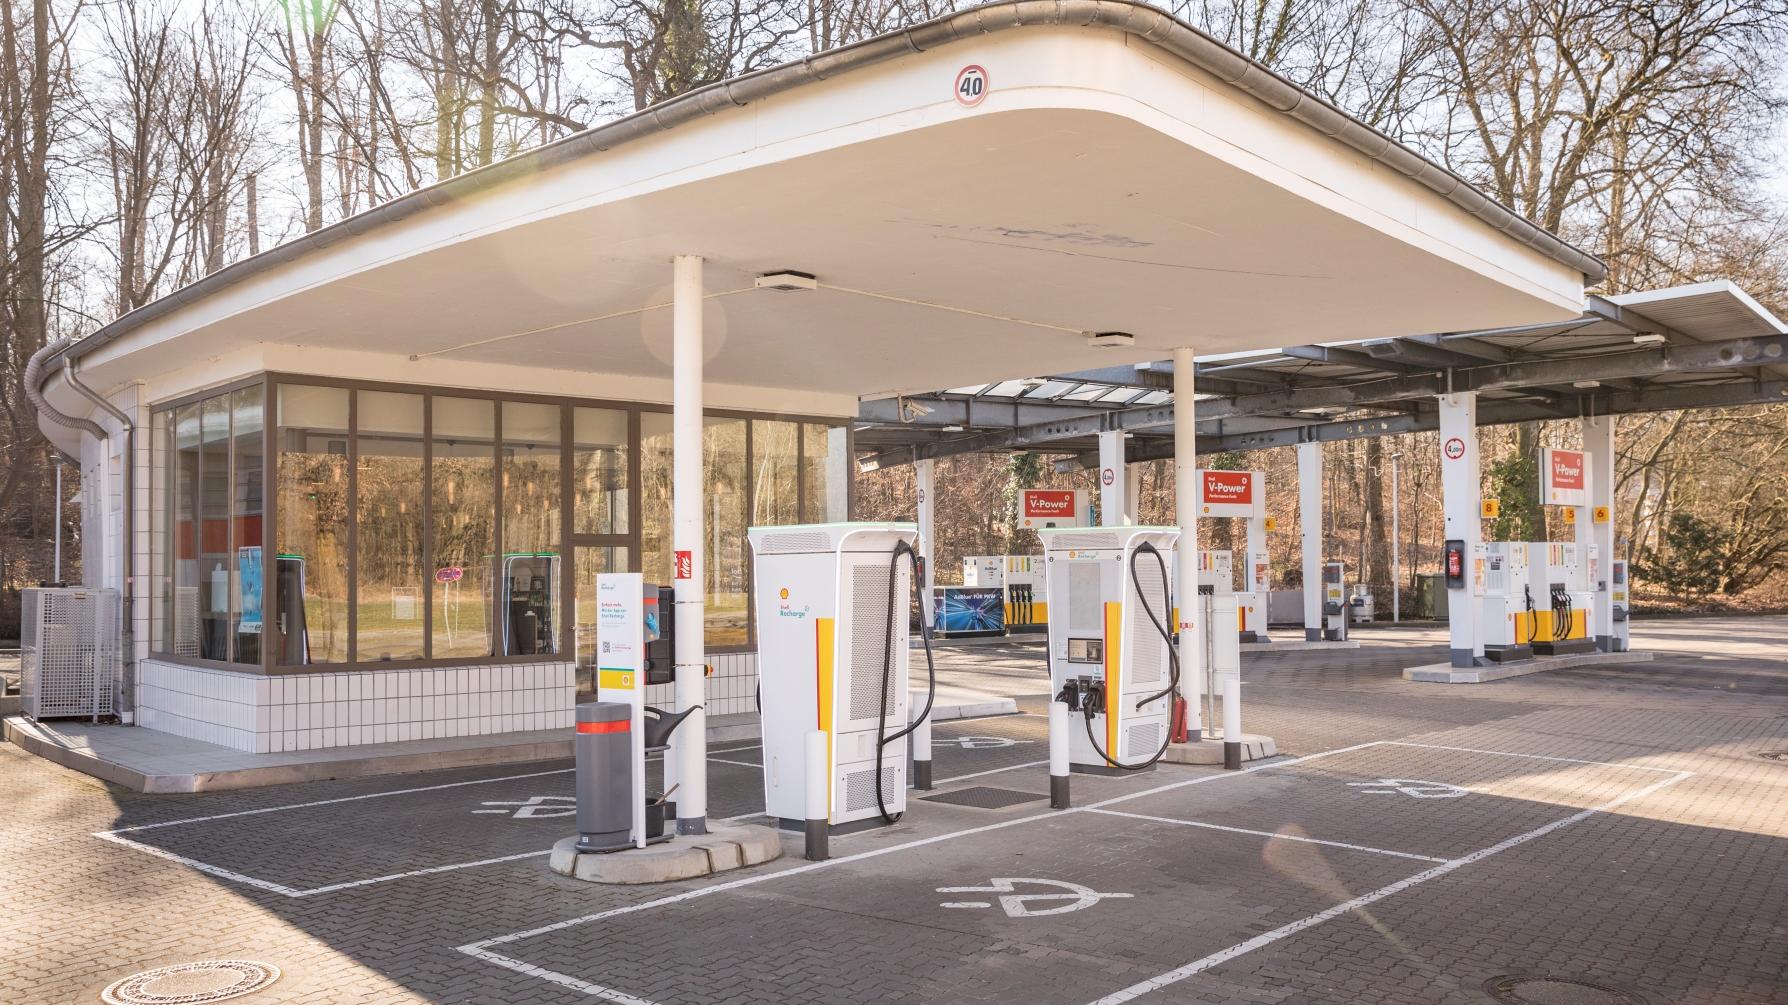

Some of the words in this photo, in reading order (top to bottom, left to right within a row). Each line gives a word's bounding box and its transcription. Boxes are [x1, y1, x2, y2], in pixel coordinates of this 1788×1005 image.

[1554, 463, 1580, 477] V-Power
[1208, 482, 1246, 493] V-Power
[1030, 499, 1068, 509] V-Power
[1485, 503, 1492, 513] 8
[1568, 510, 1575, 519] 5
[1597, 509, 1604, 518] 6
[973, 592, 983, 600] FÜR
[780, 610, 805, 619] Recharge
